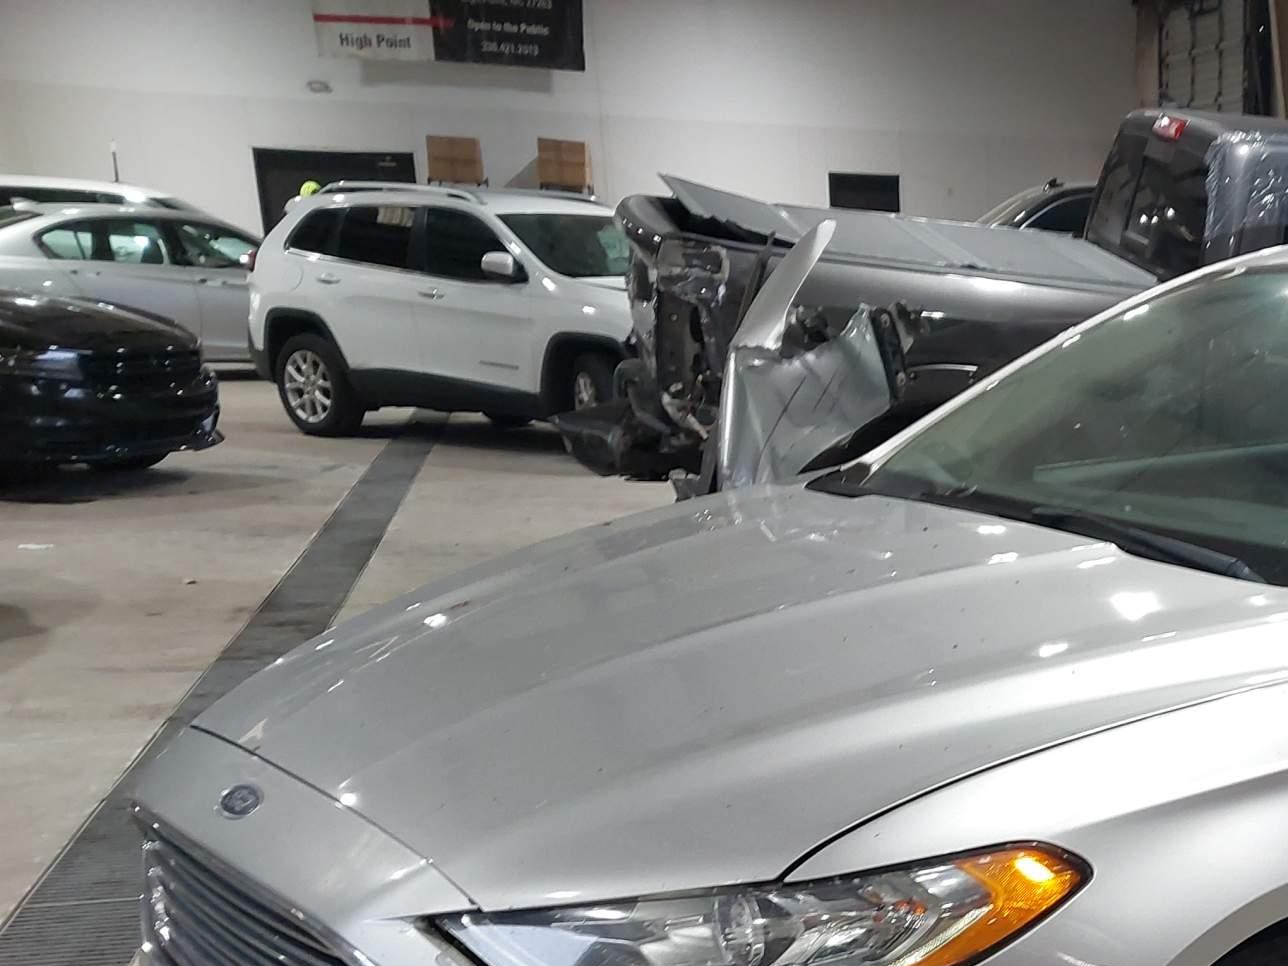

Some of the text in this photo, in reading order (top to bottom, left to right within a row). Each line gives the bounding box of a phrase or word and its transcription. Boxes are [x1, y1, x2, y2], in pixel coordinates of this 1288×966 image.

[467, 18, 549, 36] Open to the Public
[339, 32, 411, 50] High Point
